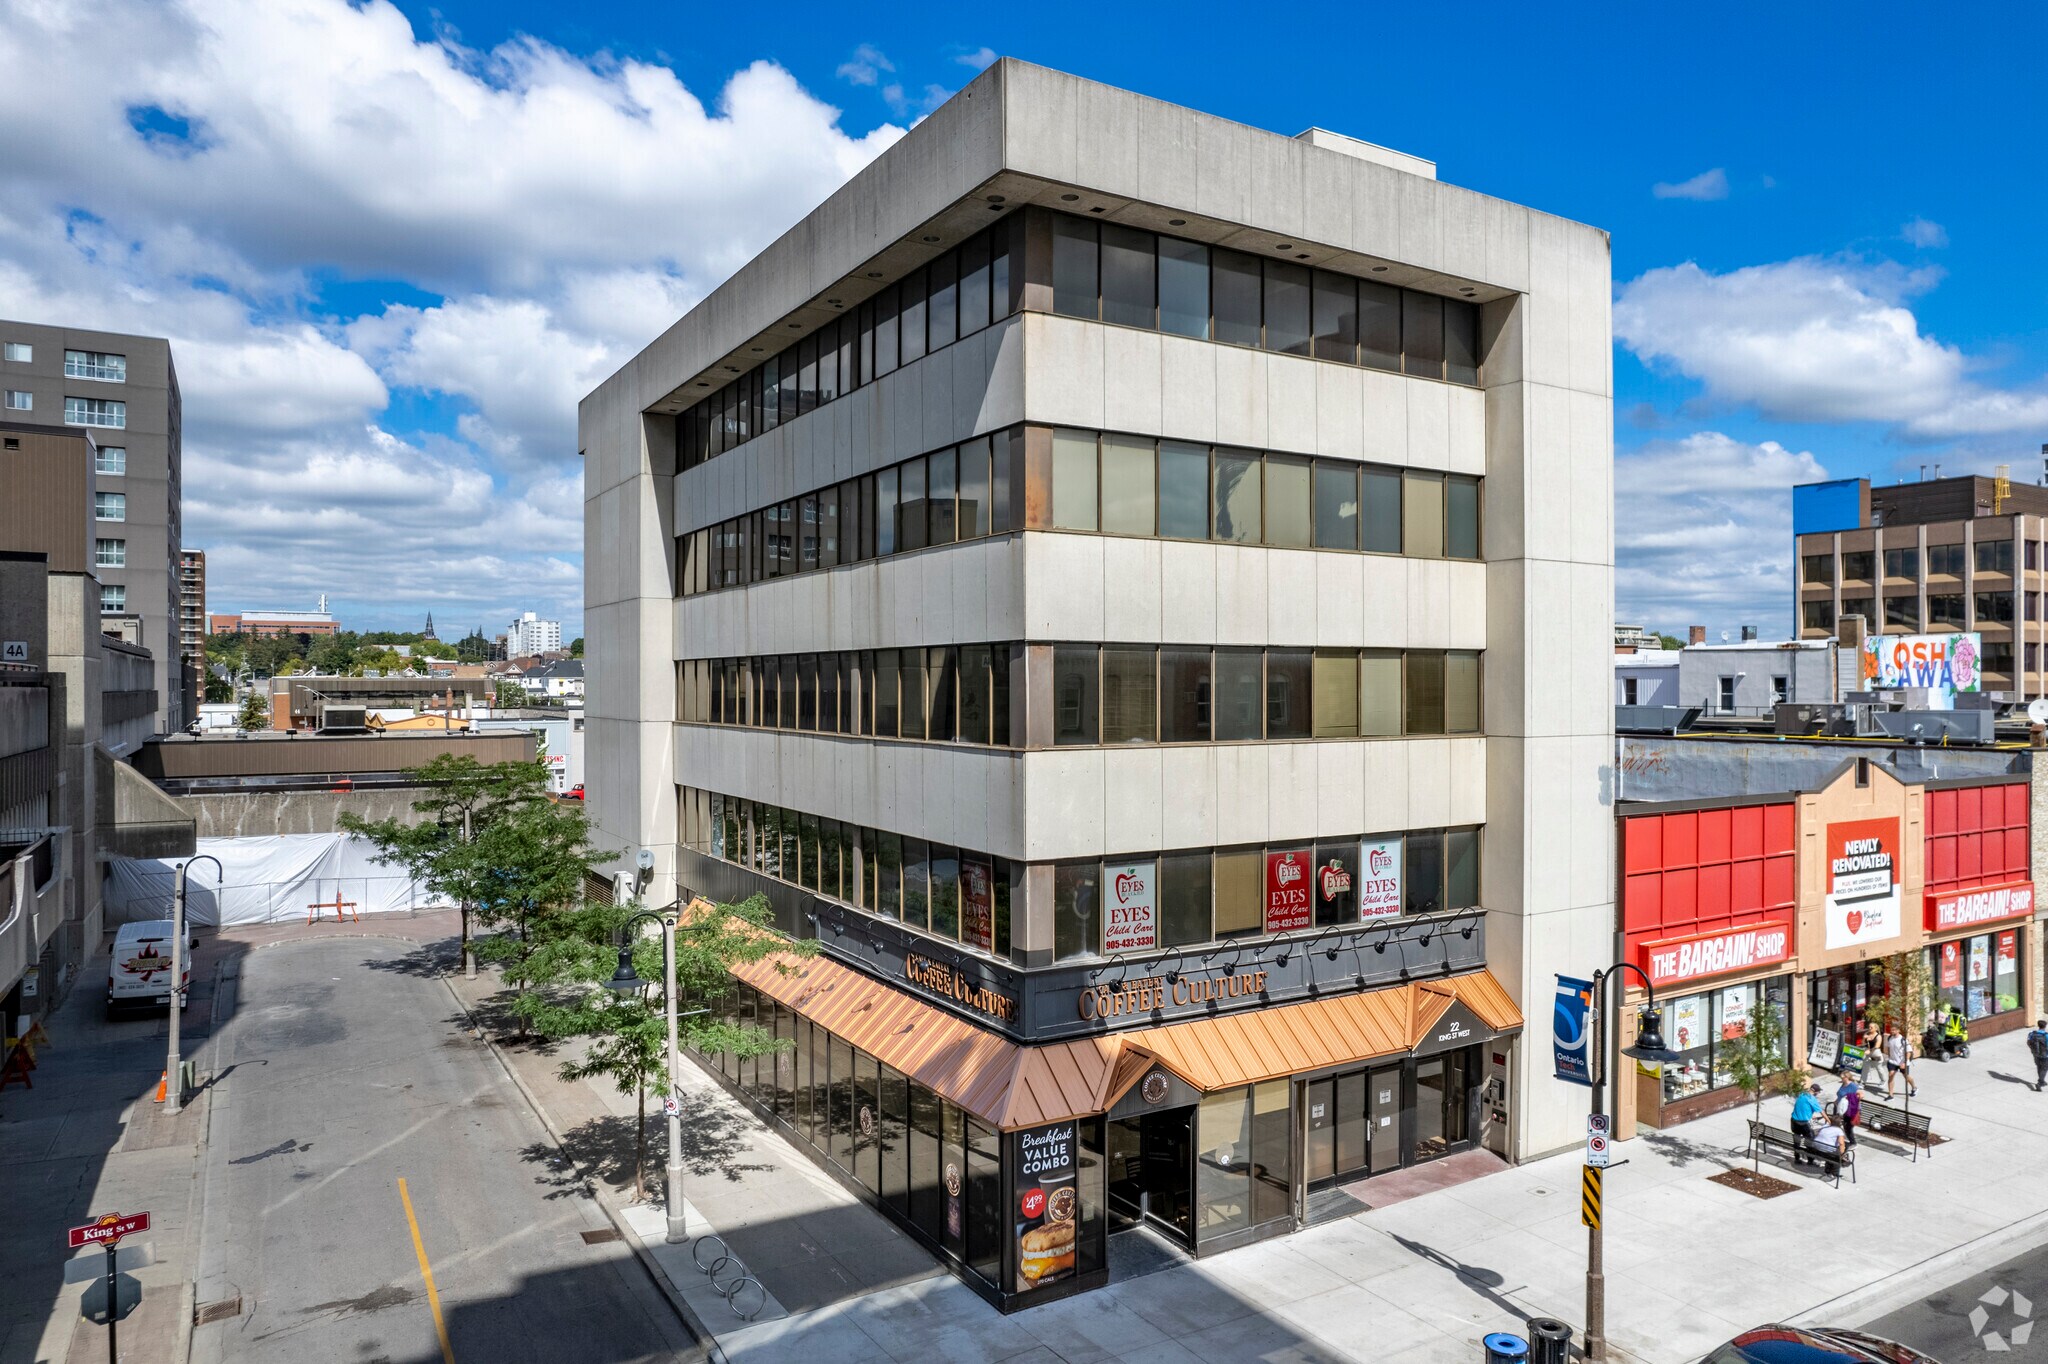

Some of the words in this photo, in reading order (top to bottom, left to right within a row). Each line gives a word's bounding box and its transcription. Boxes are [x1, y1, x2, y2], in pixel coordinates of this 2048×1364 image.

[6, 644, 24, 657] 4A
[1893, 642, 1946, 671] OSH
[1898, 661, 1956, 688] AWA
[1845, 838, 1880, 856] NEWLY
[1374, 856, 1392, 867] EYES
[1832, 853, 1891, 874] RENOVATED!
[1281, 865, 1301, 877] EYES
[1121, 880, 1144, 893] EYES
[1327, 872, 1351, 888] EYES
[1366, 878, 1397, 894] EYES
[1271, 888, 1306, 906] EYES
[1363, 894, 1381, 906] Child
[1383, 893, 1399, 904] Care
[965, 900, 989, 920] EYES
[1267, 905, 1289, 918] Child
[1291, 903, 1309, 915] Care
[1362, 904, 1399, 917] 905-432-3330
[1939, 902, 1956, 924] THE
[1956, 889, 2011, 924] BARGAIN!
[2010, 890, 2031, 911] SHOP
[1111, 905, 1150, 925] EYES
[1267, 916, 1309, 930] 905-432-3330
[1106, 924, 1131, 938] Child
[1133, 922, 1154, 935] Care
[1106, 936, 1154, 950] 905-432-3330
[1653, 952, 1677, 978] THE
[1678, 931, 1757, 977] BARGAIN!
[1756, 932, 1785, 959] SHOP
[1122, 981, 1128, 991] &
[1130, 977, 1163, 991] EATERY
[1078, 987, 1165, 1020] COFFEE
[1172, 971, 1266, 1006] CULTURE
[1725, 1003, 1744, 1012] CONNECT
[1450, 1021, 1460, 1032] 22
[1438, 1033, 1451, 1042] KING
[1458, 1029, 1470, 1037] WEST
[1557, 1052, 1584, 1066] Ontario
[1558, 1060, 1575, 1070] Tech
[1022, 1127, 1072, 1149] Breakfast
[1024, 1143, 1067, 1161] VALUE
[1023, 1155, 1070, 1174] COMBO
[83, 1227, 114, 1241] King
[116, 1225, 125, 1233] St
[126, 1221, 136, 1230] W
